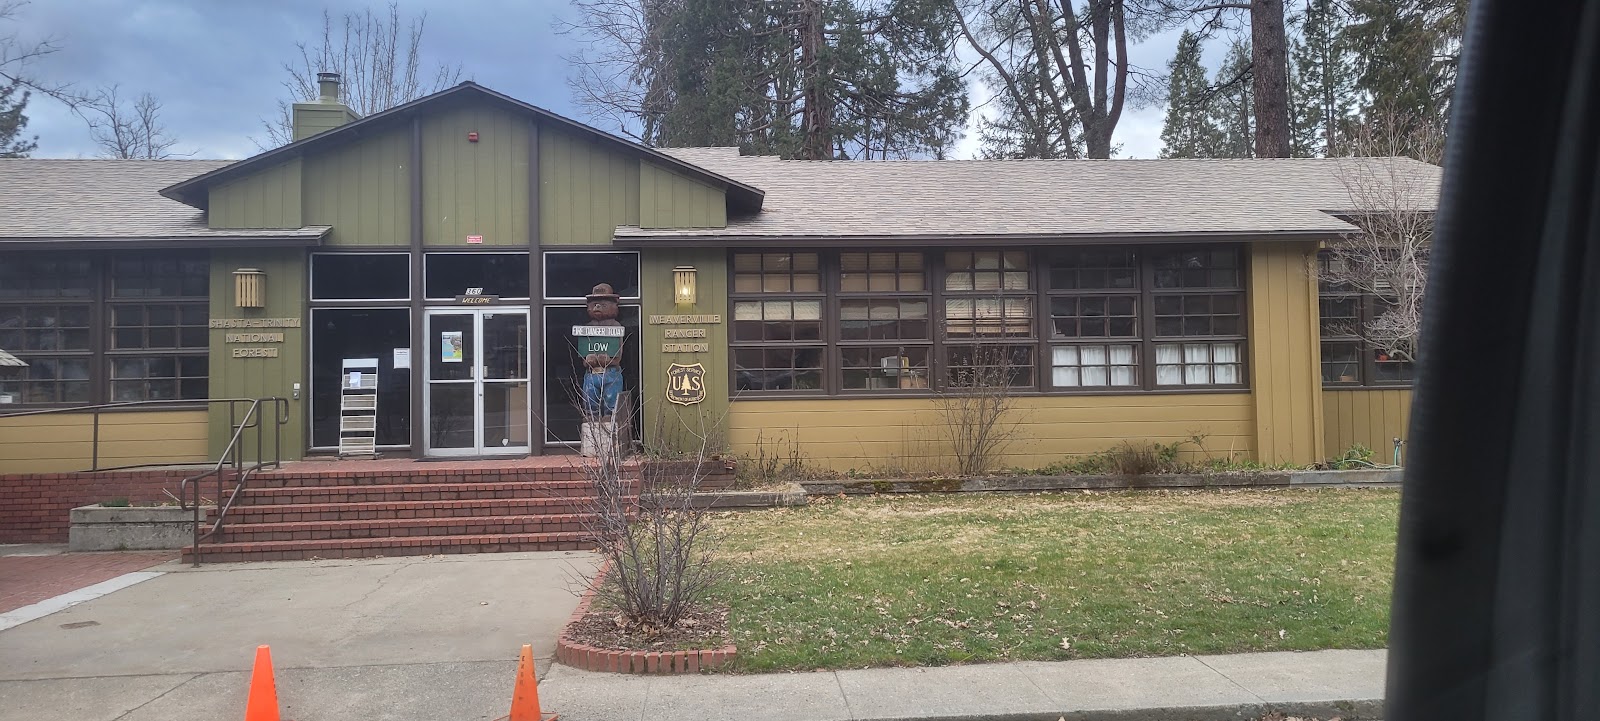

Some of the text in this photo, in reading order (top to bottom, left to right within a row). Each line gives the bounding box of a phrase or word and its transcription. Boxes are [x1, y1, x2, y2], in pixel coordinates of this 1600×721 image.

[210, 319, 300, 328] SHASTA-TRINITY
[649, 315, 719, 324] WEAVERVILLE
[585, 327, 606, 336] DANGER
[608, 327, 624, 336] TODAY
[665, 329, 704, 338] RANGER
[227, 333, 283, 342] NATIONAL
[588, 342, 609, 351] LOW
[663, 344, 707, 353] STATION
[234, 348, 276, 357] FOREST
